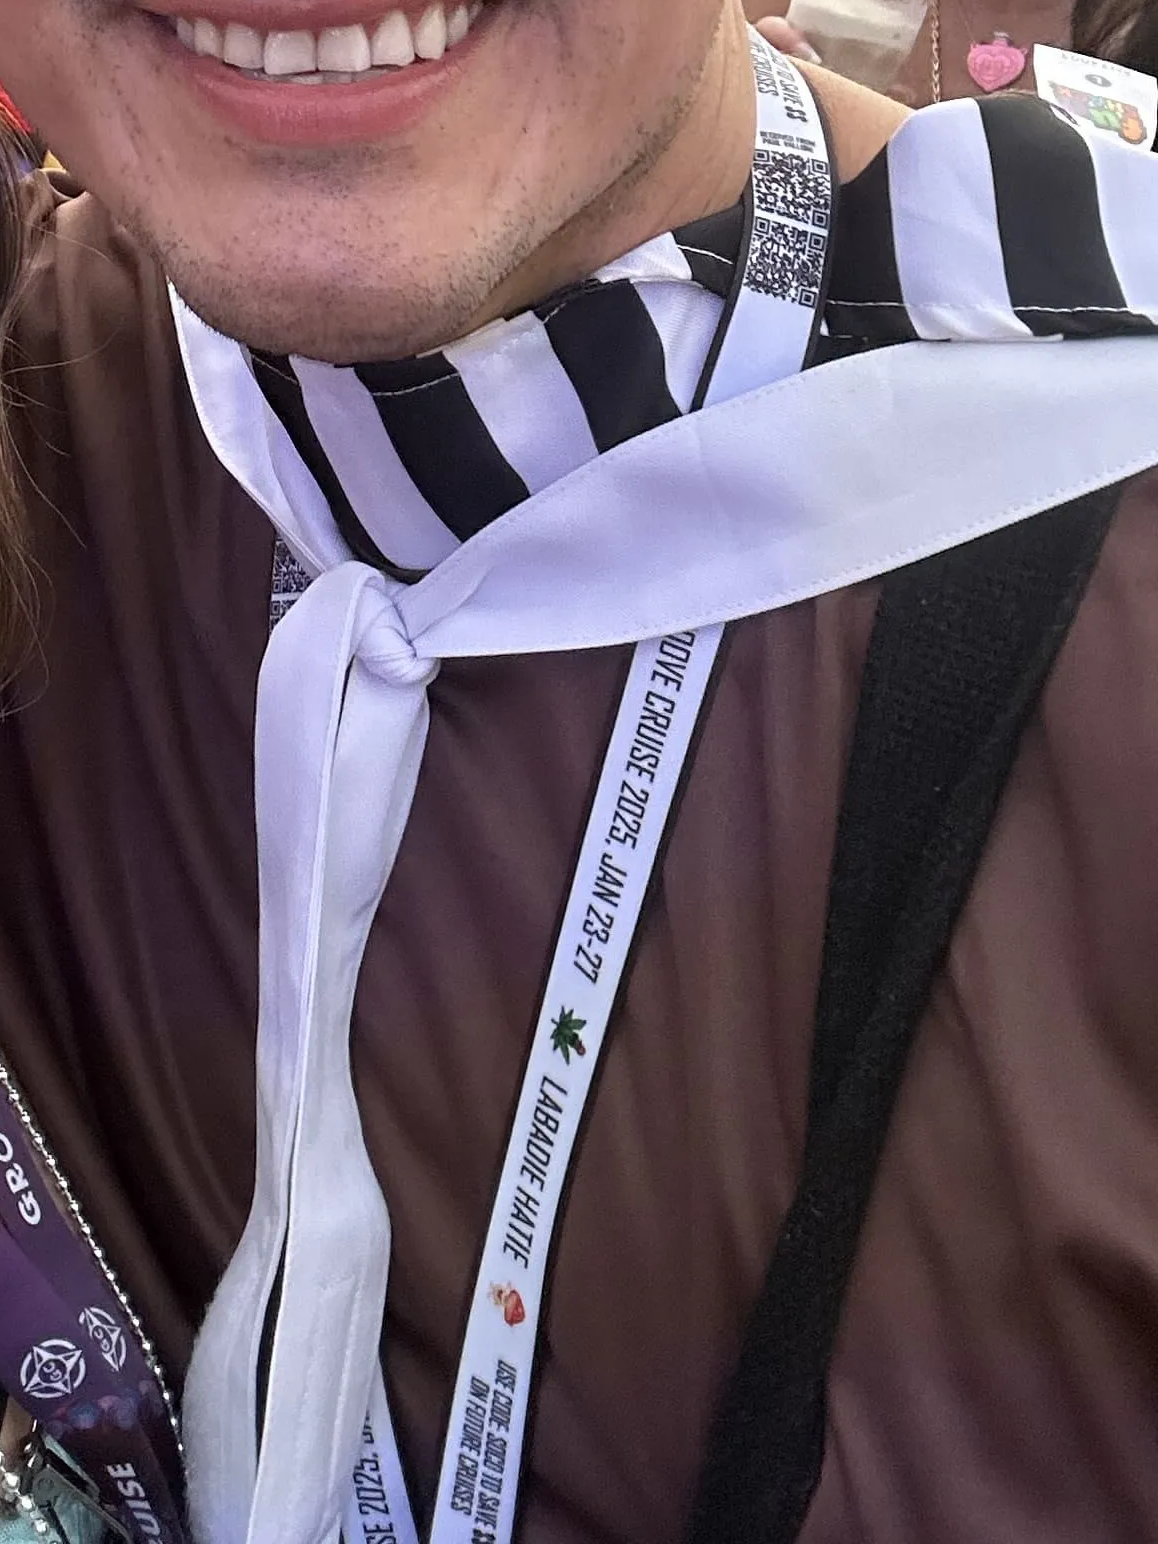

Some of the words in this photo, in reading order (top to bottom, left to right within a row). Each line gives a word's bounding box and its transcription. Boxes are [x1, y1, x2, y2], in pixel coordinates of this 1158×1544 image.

[626, 690, 676, 781] CRUISE
[593, 852, 628, 909] JAN
[573, 903, 616, 986] 23-27
[518, 1075, 568, 1193] LABADIE
[502, 1187, 541, 1269] HATIE
[469, 1375, 491, 1403] ON
[494, 1359, 517, 1393] USE
[459, 1398, 487, 1456] FUTURE
[450, 1453, 479, 1516] CRUISES
[474, 1492, 500, 1530] SAVE
[480, 1472, 503, 1494] TO
